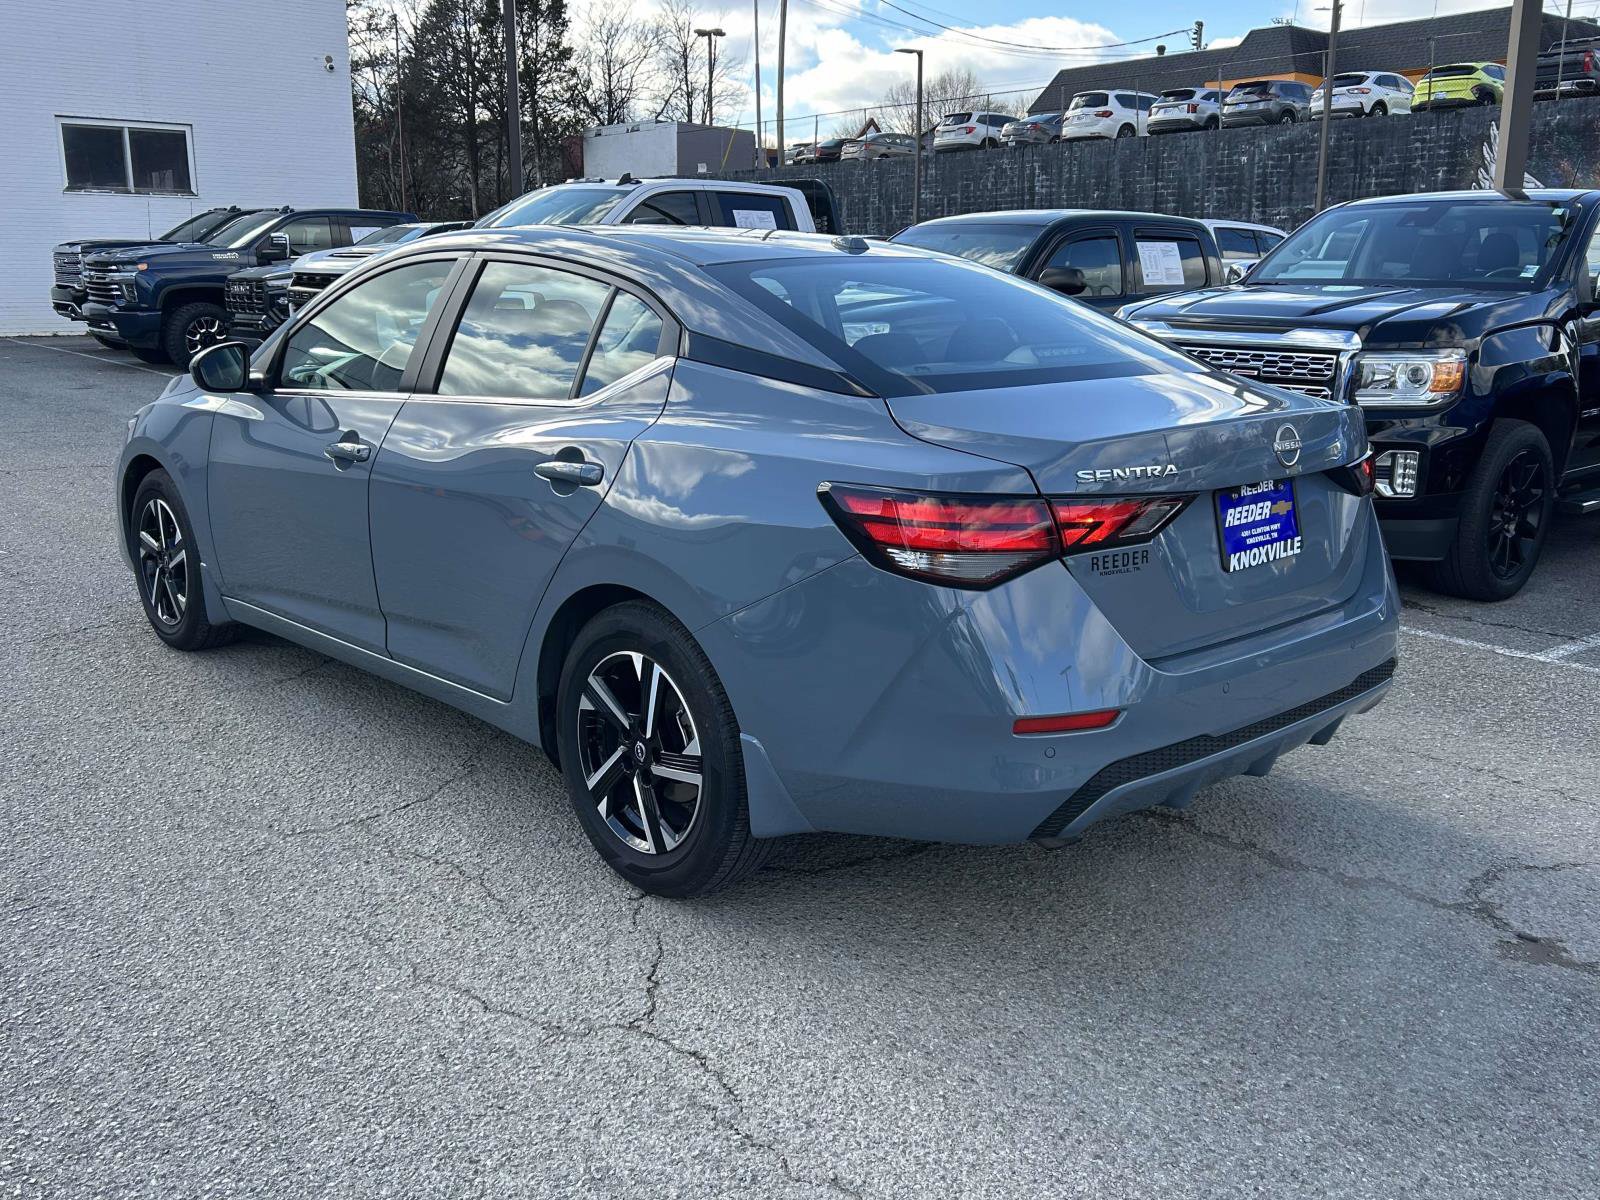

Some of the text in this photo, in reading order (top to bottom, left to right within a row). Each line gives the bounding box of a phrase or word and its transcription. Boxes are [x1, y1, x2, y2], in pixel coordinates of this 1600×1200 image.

[1274, 440, 1302, 451] NISSAN
[1076, 464, 1178, 483] SENTRA
[1240, 479, 1275, 497] REEDER
[1225, 501, 1272, 528] REEDER
[1251, 525, 1270, 535] CLINTON
[1270, 523, 1280, 531] HWY
[1091, 549, 1149, 572] REEDER
[1229, 536, 1302, 573] KNOXVILLE
